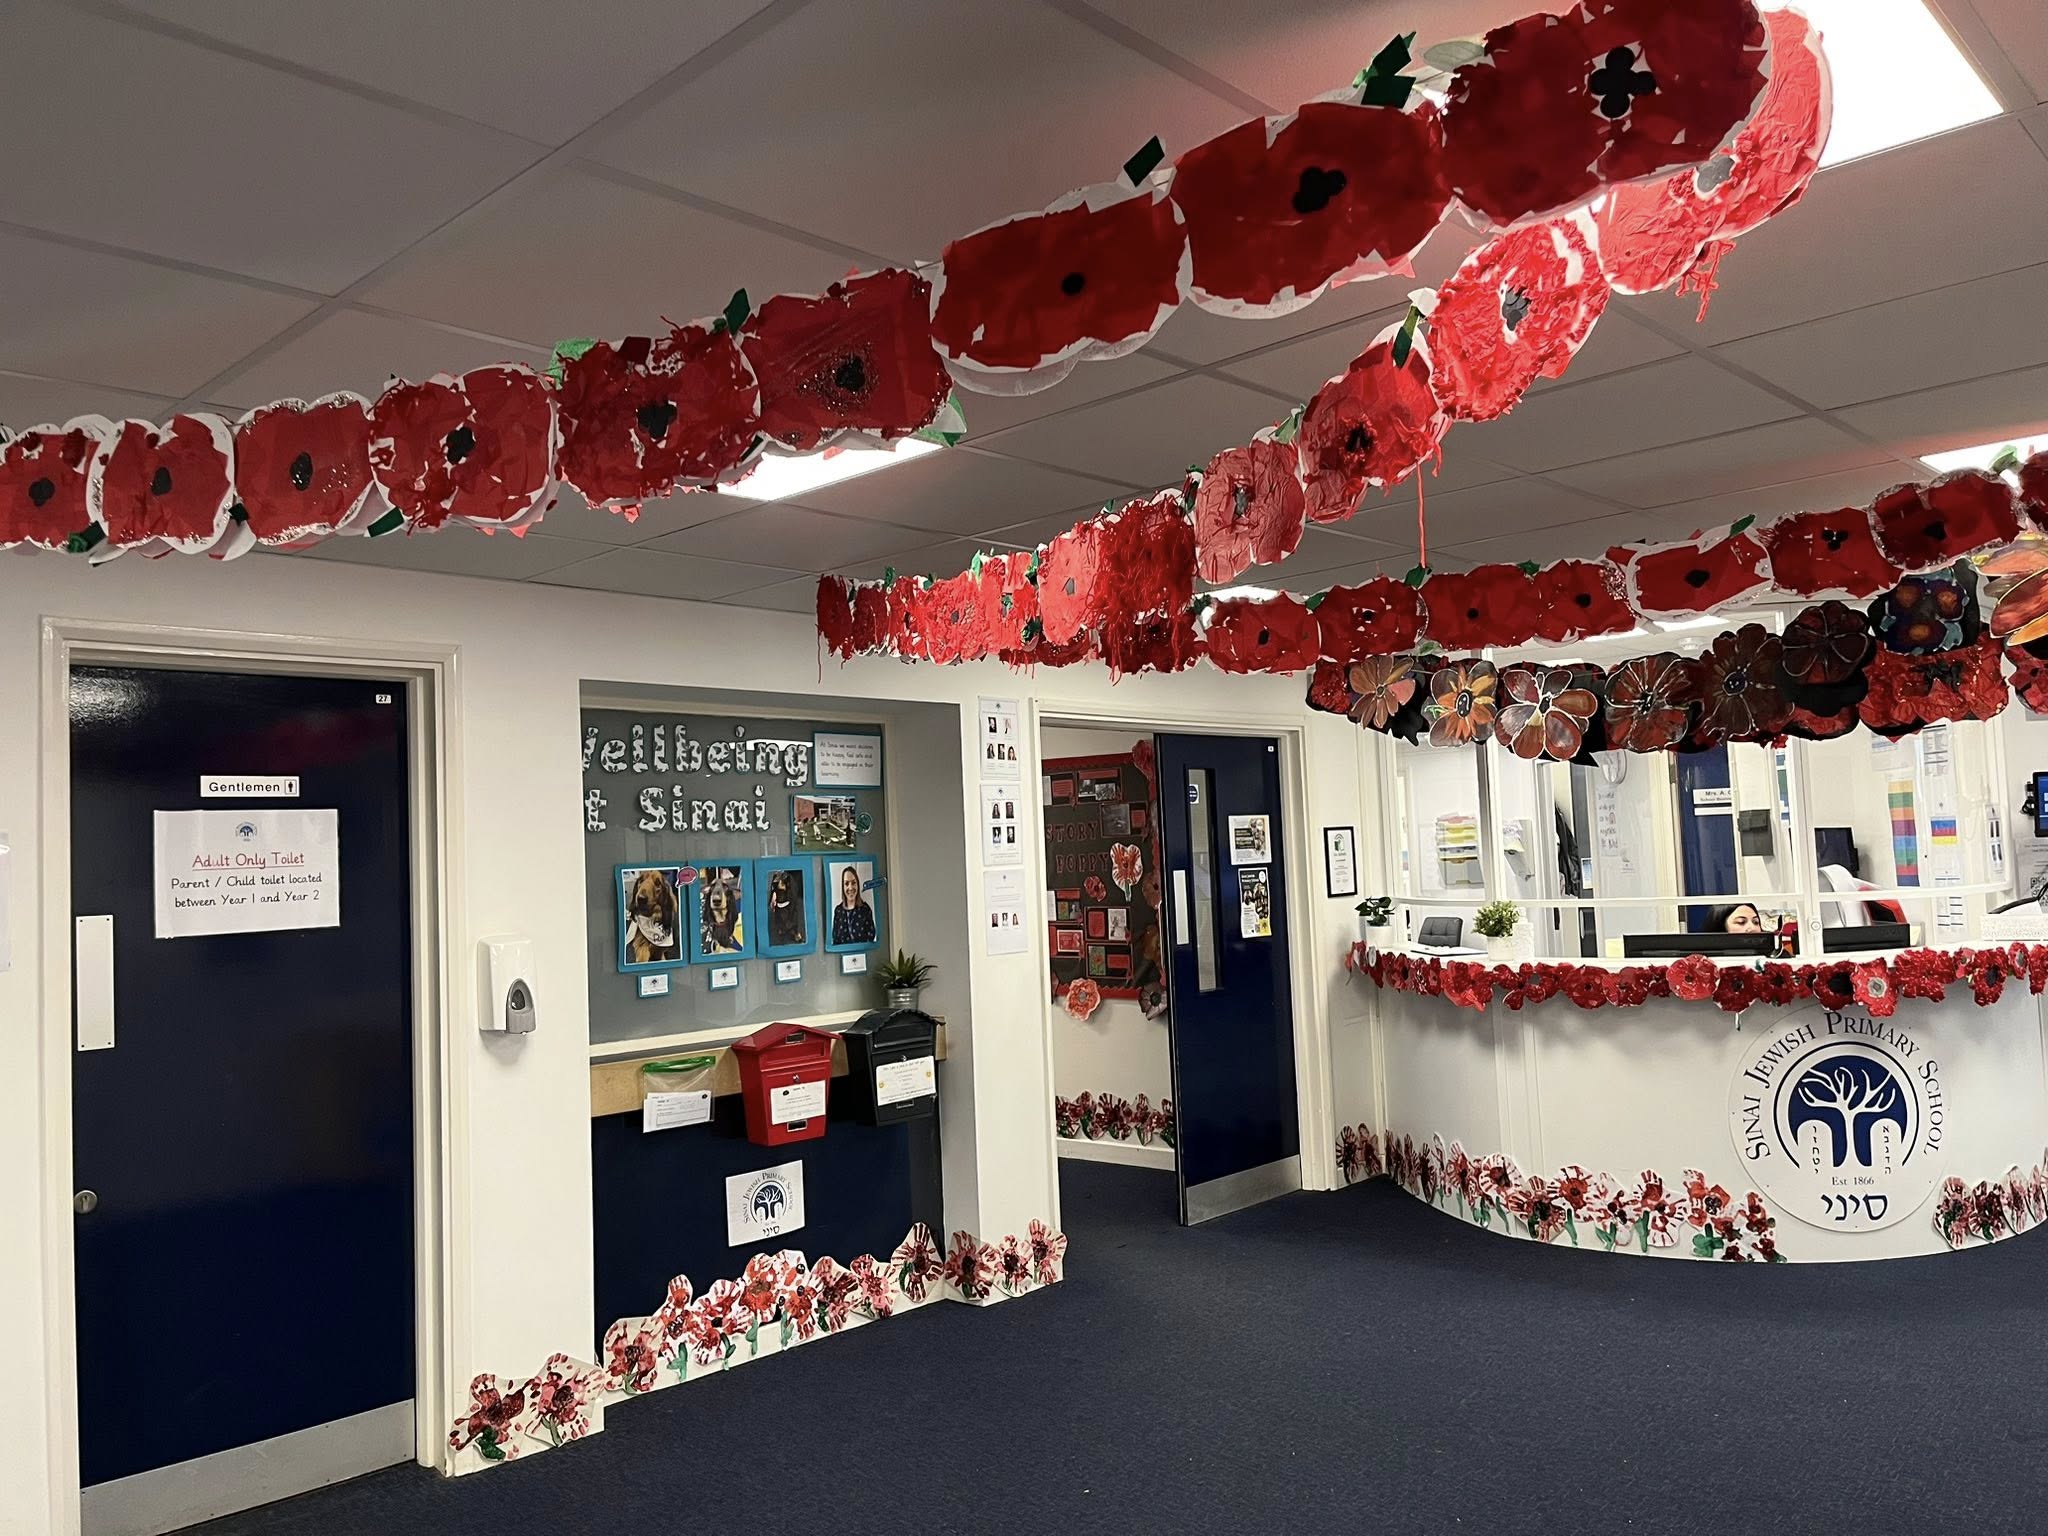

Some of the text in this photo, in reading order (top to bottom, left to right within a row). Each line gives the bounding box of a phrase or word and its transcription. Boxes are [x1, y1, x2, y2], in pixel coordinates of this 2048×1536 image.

[582, 724, 809, 787] ellbeing
[208, 782, 280, 792] Gentlemen
[638, 784, 770, 832] Sinai
[192, 852, 304, 870] Adult Only Toilet
[1056, 852, 1110, 874] POPPY
[171, 872, 322, 890] Parent / Child toilet located
[175, 897, 216, 908] between
[220, 894, 247, 905] Year
[260, 892, 280, 902] and
[284, 891, 308, 902] Year
[312, 890, 320, 900] 2
[1742, 1012, 1944, 1161] SINAI JEWISH PRIMARY SCHOOL
[1831, 1176, 1875, 1186] Est 1866
[1820, 1194, 1888, 1221] סיני
[762, 1226, 780, 1237] סיני
